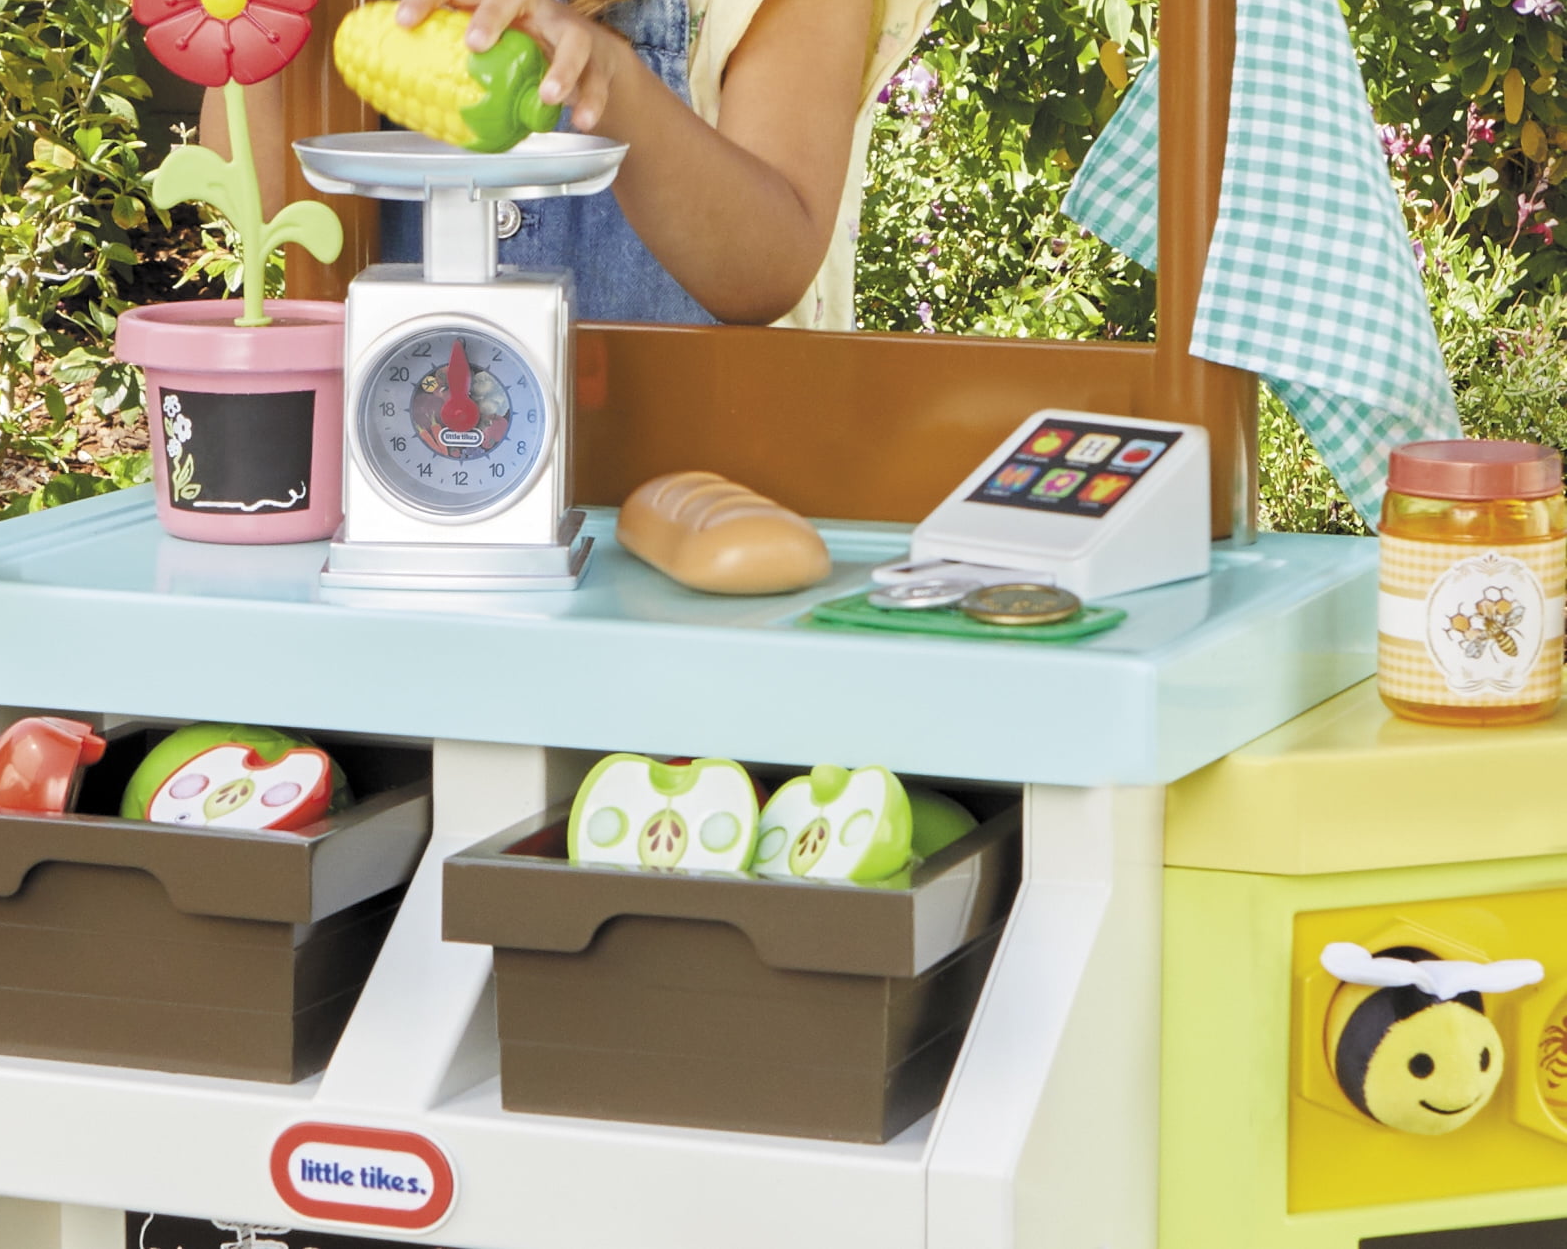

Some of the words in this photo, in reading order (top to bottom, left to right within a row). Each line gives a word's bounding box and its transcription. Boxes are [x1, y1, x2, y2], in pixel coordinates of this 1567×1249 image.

[412, 342, 432, 358] 22
[493, 347, 503, 362] 2
[390, 366, 410, 382] 20
[517, 375, 527, 389] 4
[379, 402, 395, 417] 18
[528, 410, 537, 423] 6
[390, 437, 406, 451] 16
[517, 440, 526, 455] 8
[417, 463, 433, 477] 14
[489, 463, 505, 478] 10
[452, 471, 469, 486] 12
[300, 1158, 354, 1186] little
